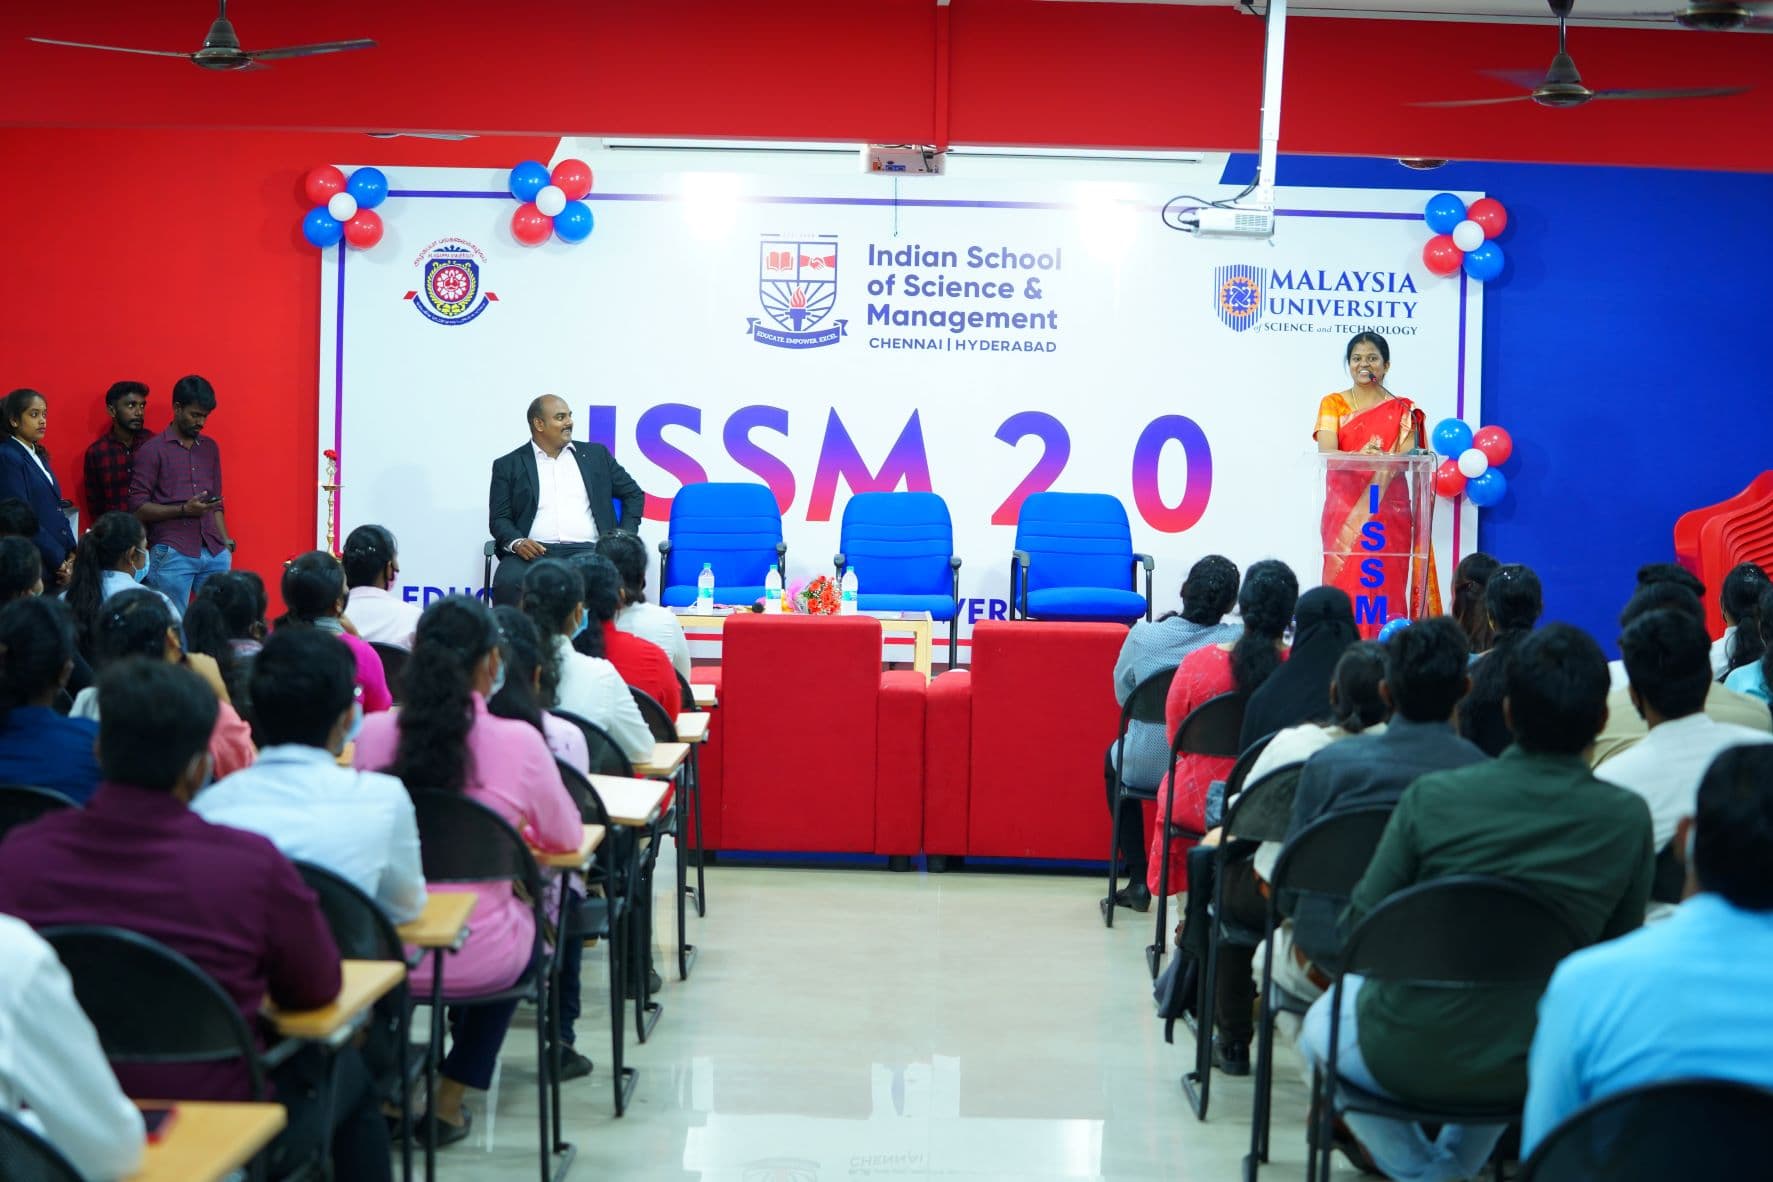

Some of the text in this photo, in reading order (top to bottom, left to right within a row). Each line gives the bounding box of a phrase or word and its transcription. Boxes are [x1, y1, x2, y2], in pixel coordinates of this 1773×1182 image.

[868, 243, 1062, 270] Indian School
[867, 273, 1043, 300] of Science &
[1270, 269, 1418, 294] MALAYSIA
[867, 303, 1058, 333] Management
[1269, 297, 1418, 319] UNIVERSITY
[1264, 322, 1314, 333] SCIENCE
[1316, 325, 1333, 333] and
[1336, 324, 1418, 335] TECHNOLOGY
[868, 337, 943, 350] CHENNAI
[955, 339, 1057, 353] HYDERABAD
[1355, 484, 1389, 625] ISSM
